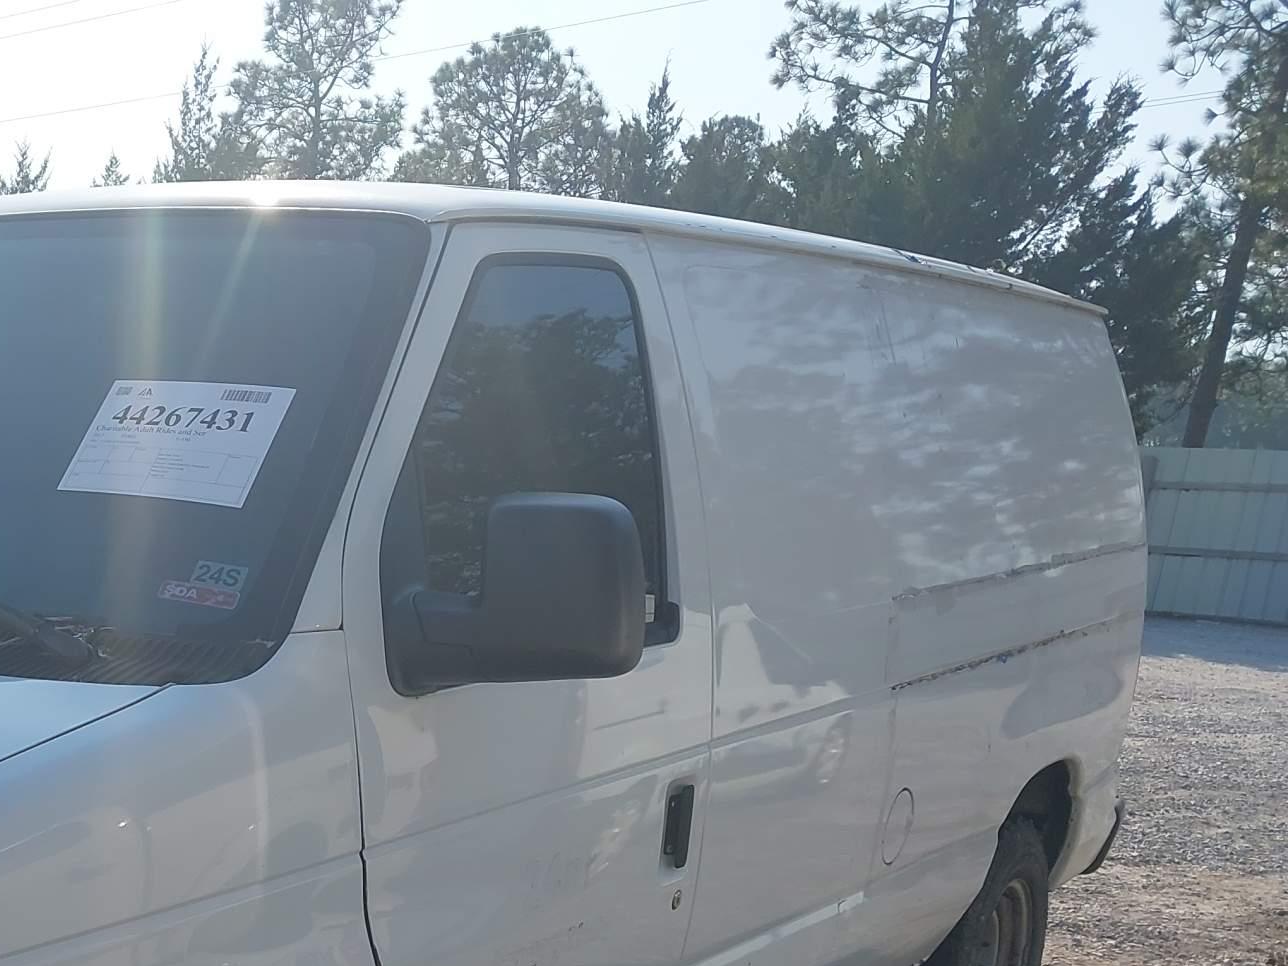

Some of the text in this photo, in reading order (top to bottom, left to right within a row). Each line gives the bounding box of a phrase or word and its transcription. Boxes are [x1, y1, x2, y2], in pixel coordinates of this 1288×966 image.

[112, 405, 255, 432] 44267431
[156, 426, 176, 435] Rides
[177, 427, 193, 436] and
